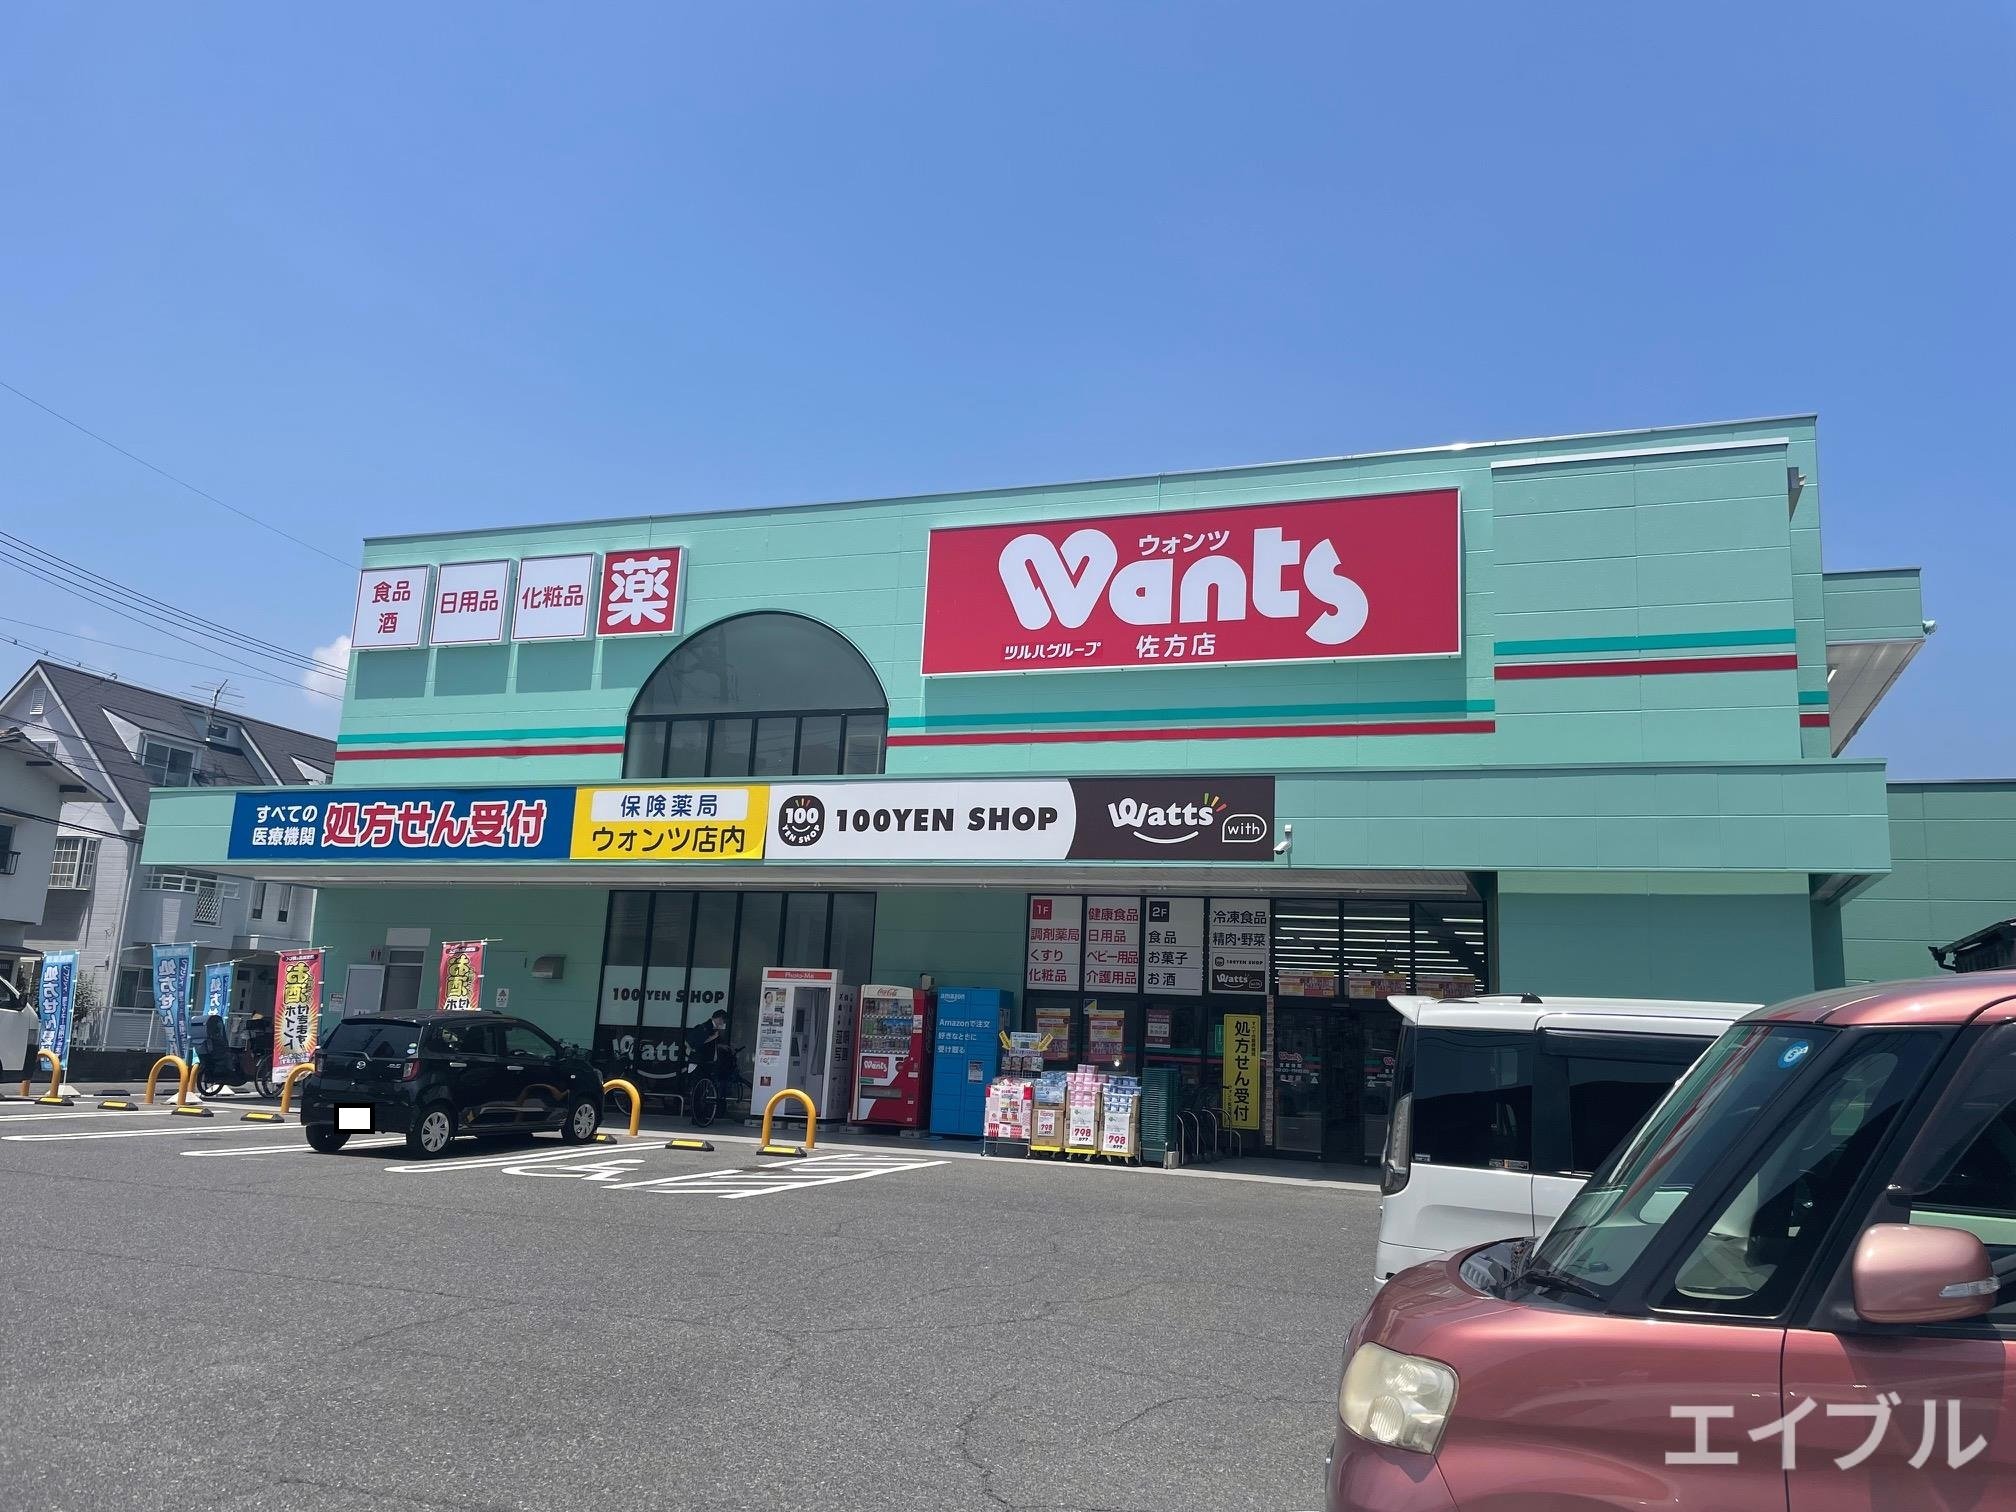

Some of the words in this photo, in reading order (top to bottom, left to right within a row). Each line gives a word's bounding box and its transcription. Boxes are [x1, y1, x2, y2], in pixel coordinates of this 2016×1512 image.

[1138, 529, 1230, 556] ウォンツ
[372, 581, 411, 604] 食品
[606, 557, 672, 626] 薬
[998, 526, 1369, 645] Wants
[440, 590, 499, 614] 日用品
[522, 584, 584, 610] 化粧品
[377, 612, 399, 634] 酒
[1004, 641, 1101, 660] ツルハグループ
[1136, 633, 1216, 658] 佐方店
[620, 794, 719, 819] 保険薬局
[1108, 797, 1214, 828] Watts
[256, 805, 318, 824] すべての
[785, 807, 819, 824] 100
[836, 808, 954, 833] 100YEN
[967, 806, 1058, 831] SHOP
[321, 799, 546, 850] 処方せん受付
[1227, 821, 1261, 836] with
[252, 827, 315, 846] 医療機関
[591, 826, 745, 853] ウォンツ店内
[782, 824, 796, 842] YEN
[798, 824, 820, 844] SHOP
[1037, 904, 1050, 915] 1F
[1088, 908, 1139, 922] 健康食品
[1152, 906, 1168, 917] 2F
[1213, 910, 1267, 925] 冷凍食品
[1030, 928, 1080, 942] 調剤薬局
[1088, 929, 1126, 943] 日用品
[1148, 931, 1177, 944] 食品
[1212, 932, 1266, 947] 精肉・野菜
[1030, 949, 1063, 962] くすり
[1087, 951, 1139, 965] ベビー用品
[1148, 951, 1188, 965] お菓子
[1029, 968, 1067, 982] 化粧品
[1087, 970, 1137, 985] 介護用品
[1147, 972, 1176, 987] お酒
[1216, 973, 1248, 984] Watts
[613, 987, 641, 1001] 100
[646, 990, 671, 1001] YEN
[676, 990, 725, 1004] SHOP
[939, 1018, 990, 1029] Amazonで注文
[938, 1031, 977, 1042] 好きなときに
[938, 1044, 966, 1054] 受け取る
[863, 1060, 887, 1072] Wants
[1234, 1020, 1250, 1122] 処方せん受付
[1074, 1128, 1091, 1137] 798
[1108, 1135, 1126, 1145] 798
